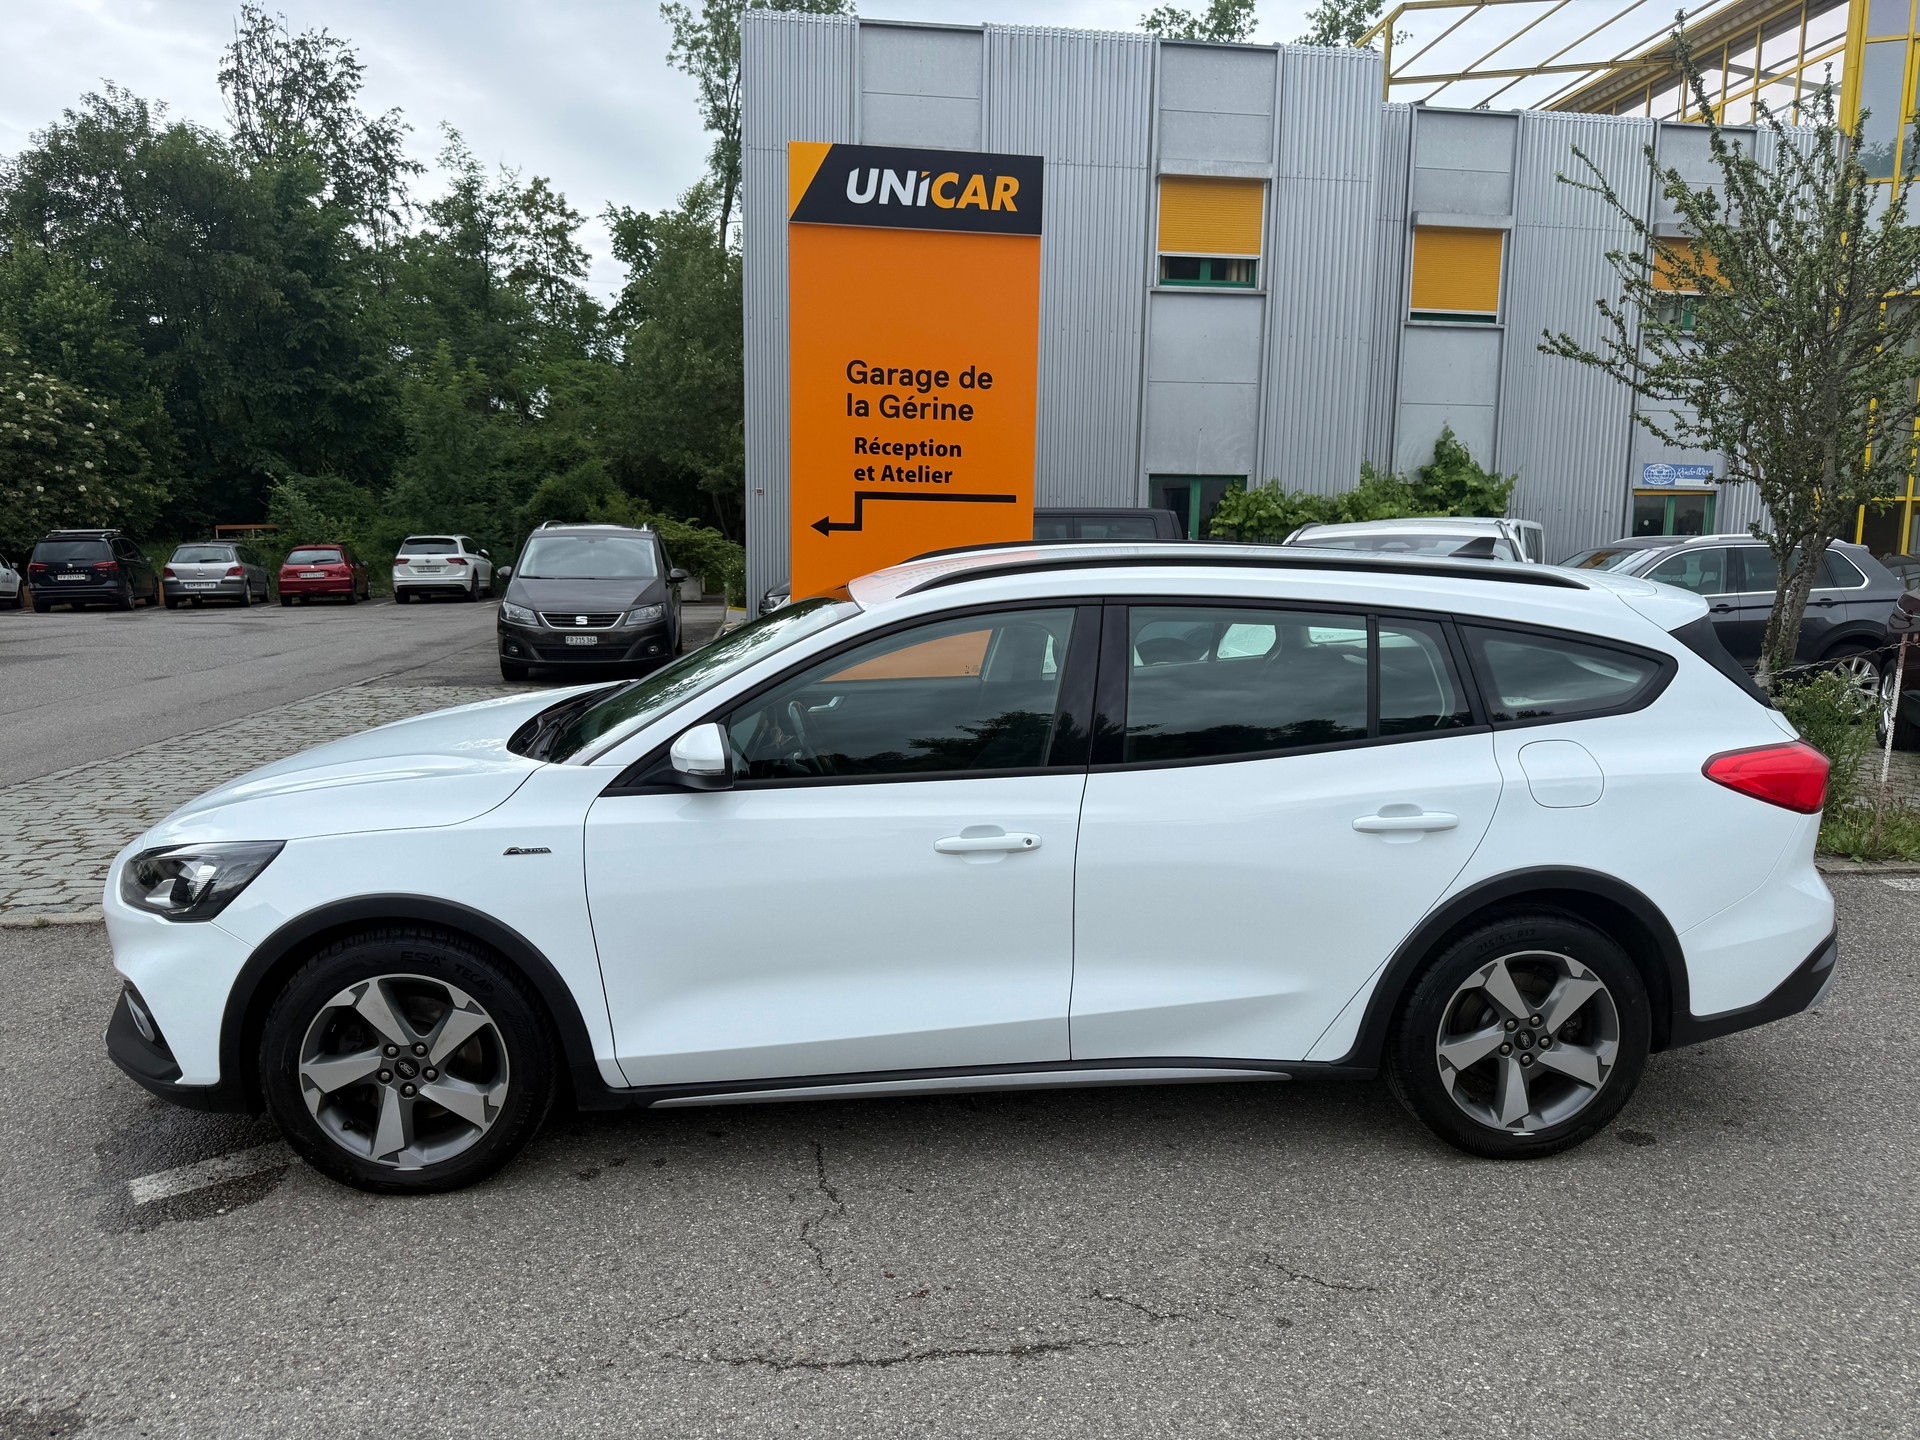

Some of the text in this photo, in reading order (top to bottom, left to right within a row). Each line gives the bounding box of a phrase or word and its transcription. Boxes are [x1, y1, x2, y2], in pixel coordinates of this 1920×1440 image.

[846, 359, 993, 394] Garage de
[846, 392, 974, 421] la Gérine
[854, 437, 962, 461] Réception
[853, 465, 953, 484] et Atelier
